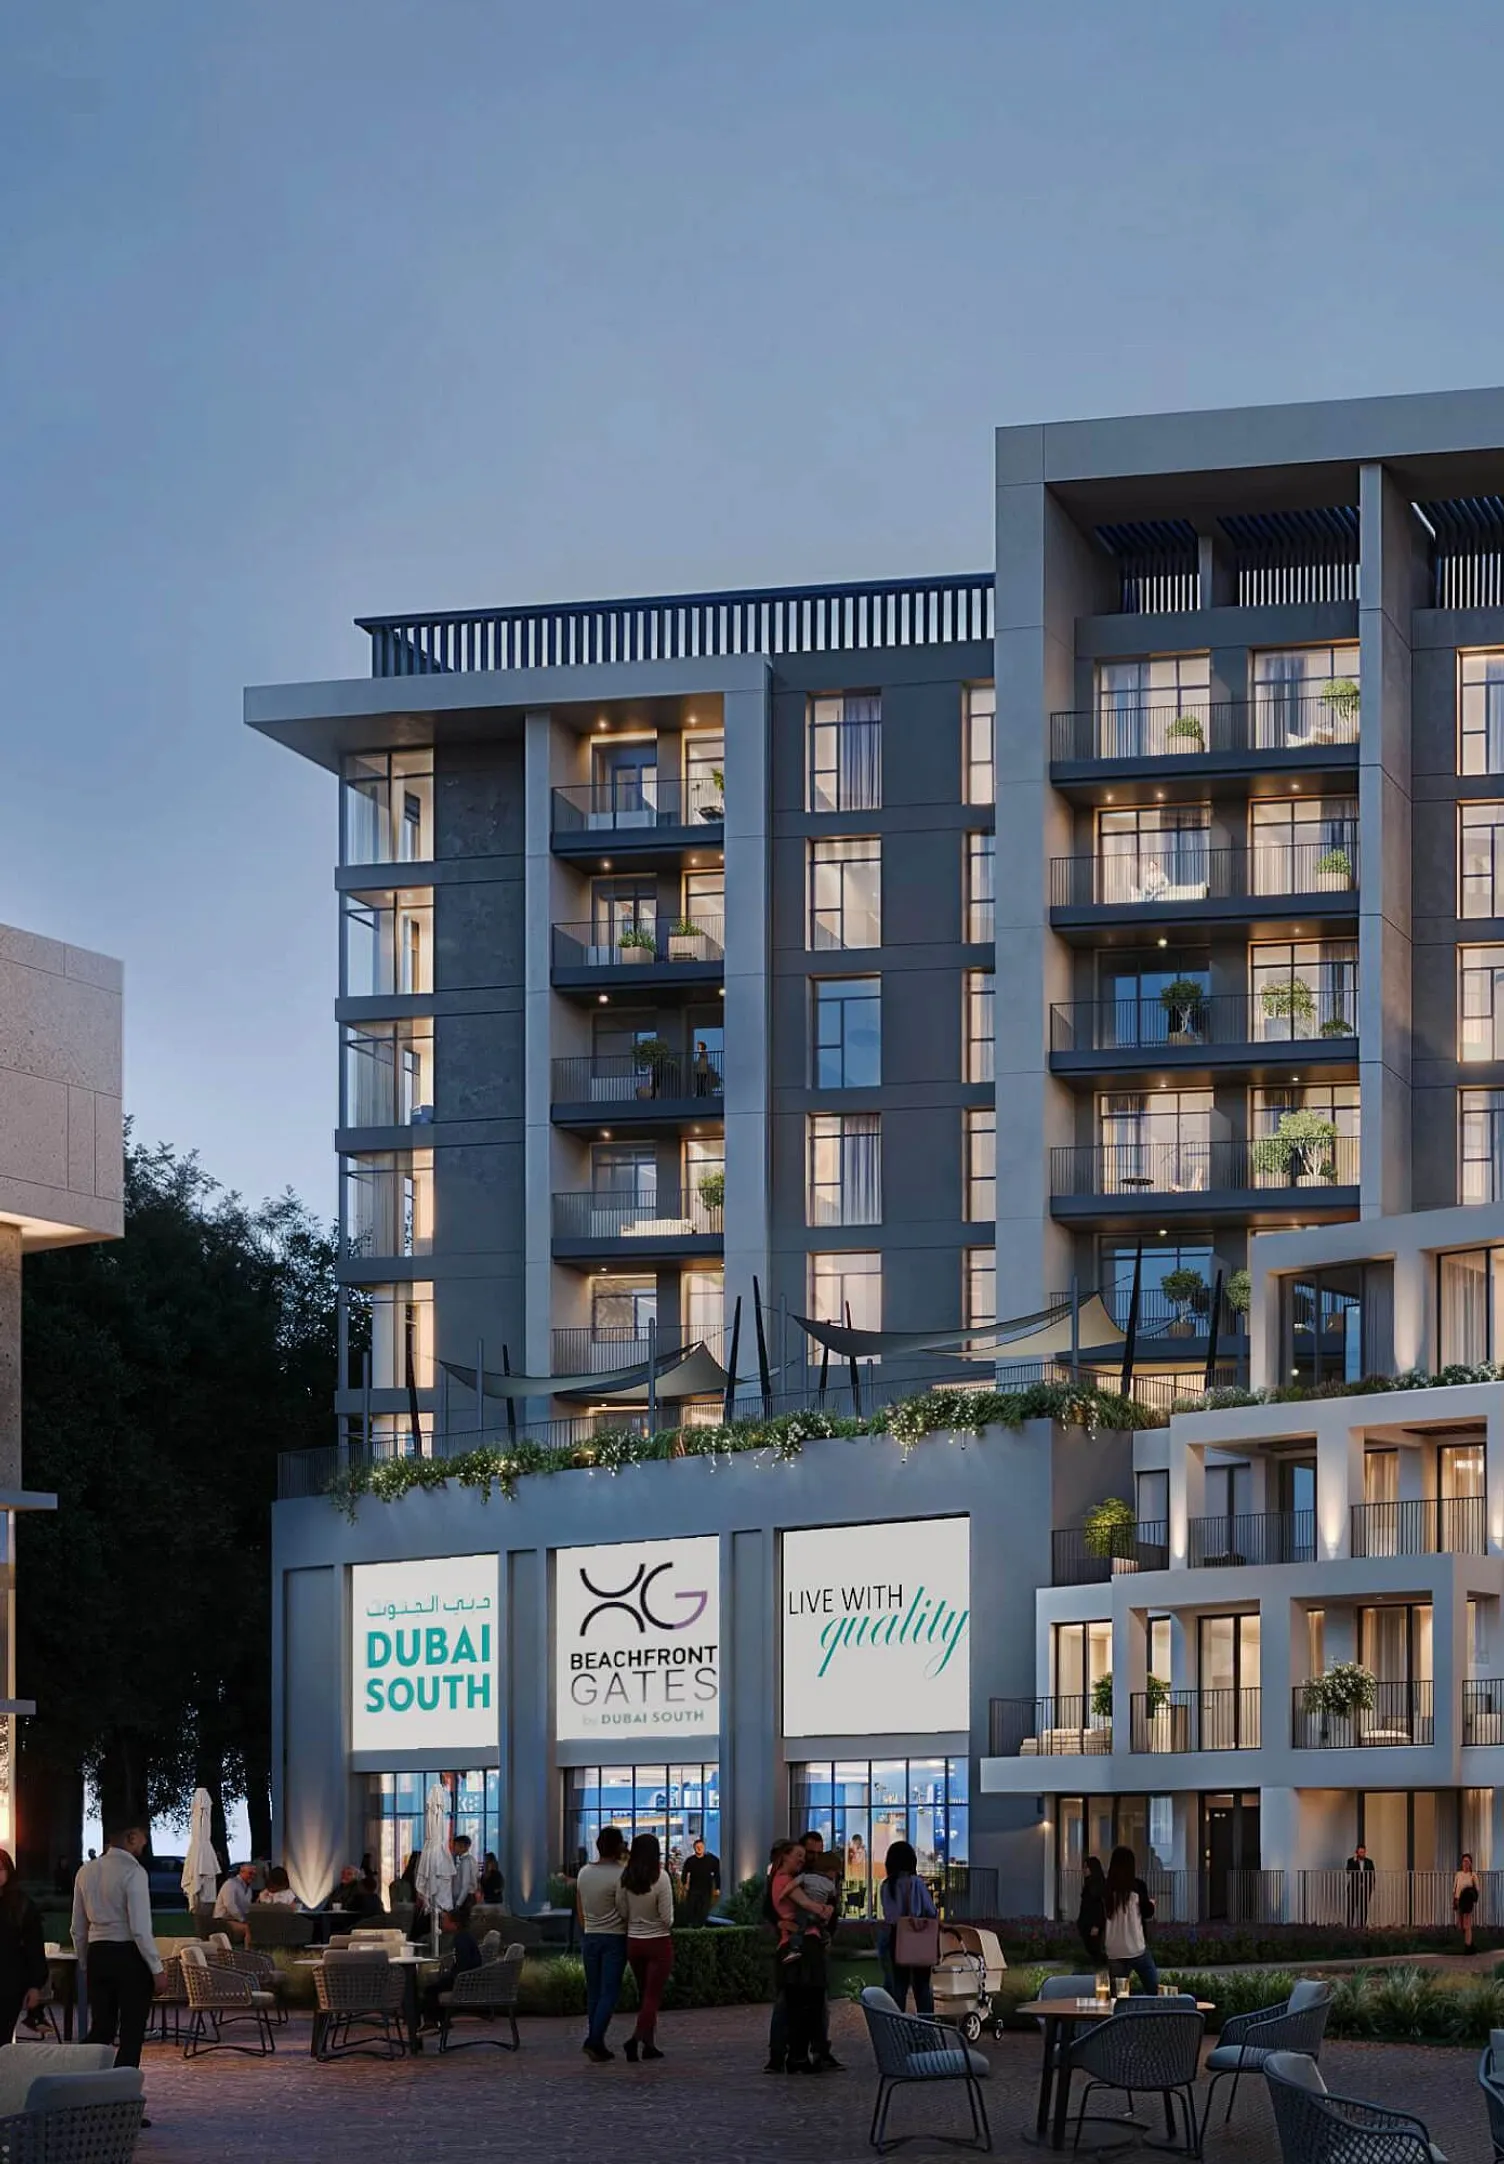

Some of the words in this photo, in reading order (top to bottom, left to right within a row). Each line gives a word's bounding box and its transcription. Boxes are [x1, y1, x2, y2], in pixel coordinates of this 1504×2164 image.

[789, 1588, 834, 1615] LIVE
[841, 1584, 903, 1611] WITH
[366, 1623, 491, 1669] DUBAI
[817, 1585, 970, 1679] quality
[570, 1645, 718, 1671] BEACHFRONT
[365, 1672, 491, 1713] SOUTH
[571, 1667, 718, 1706] GATES
[601, 1713, 648, 1725] DUBAI
[652, 1709, 705, 1724] SOUTH
